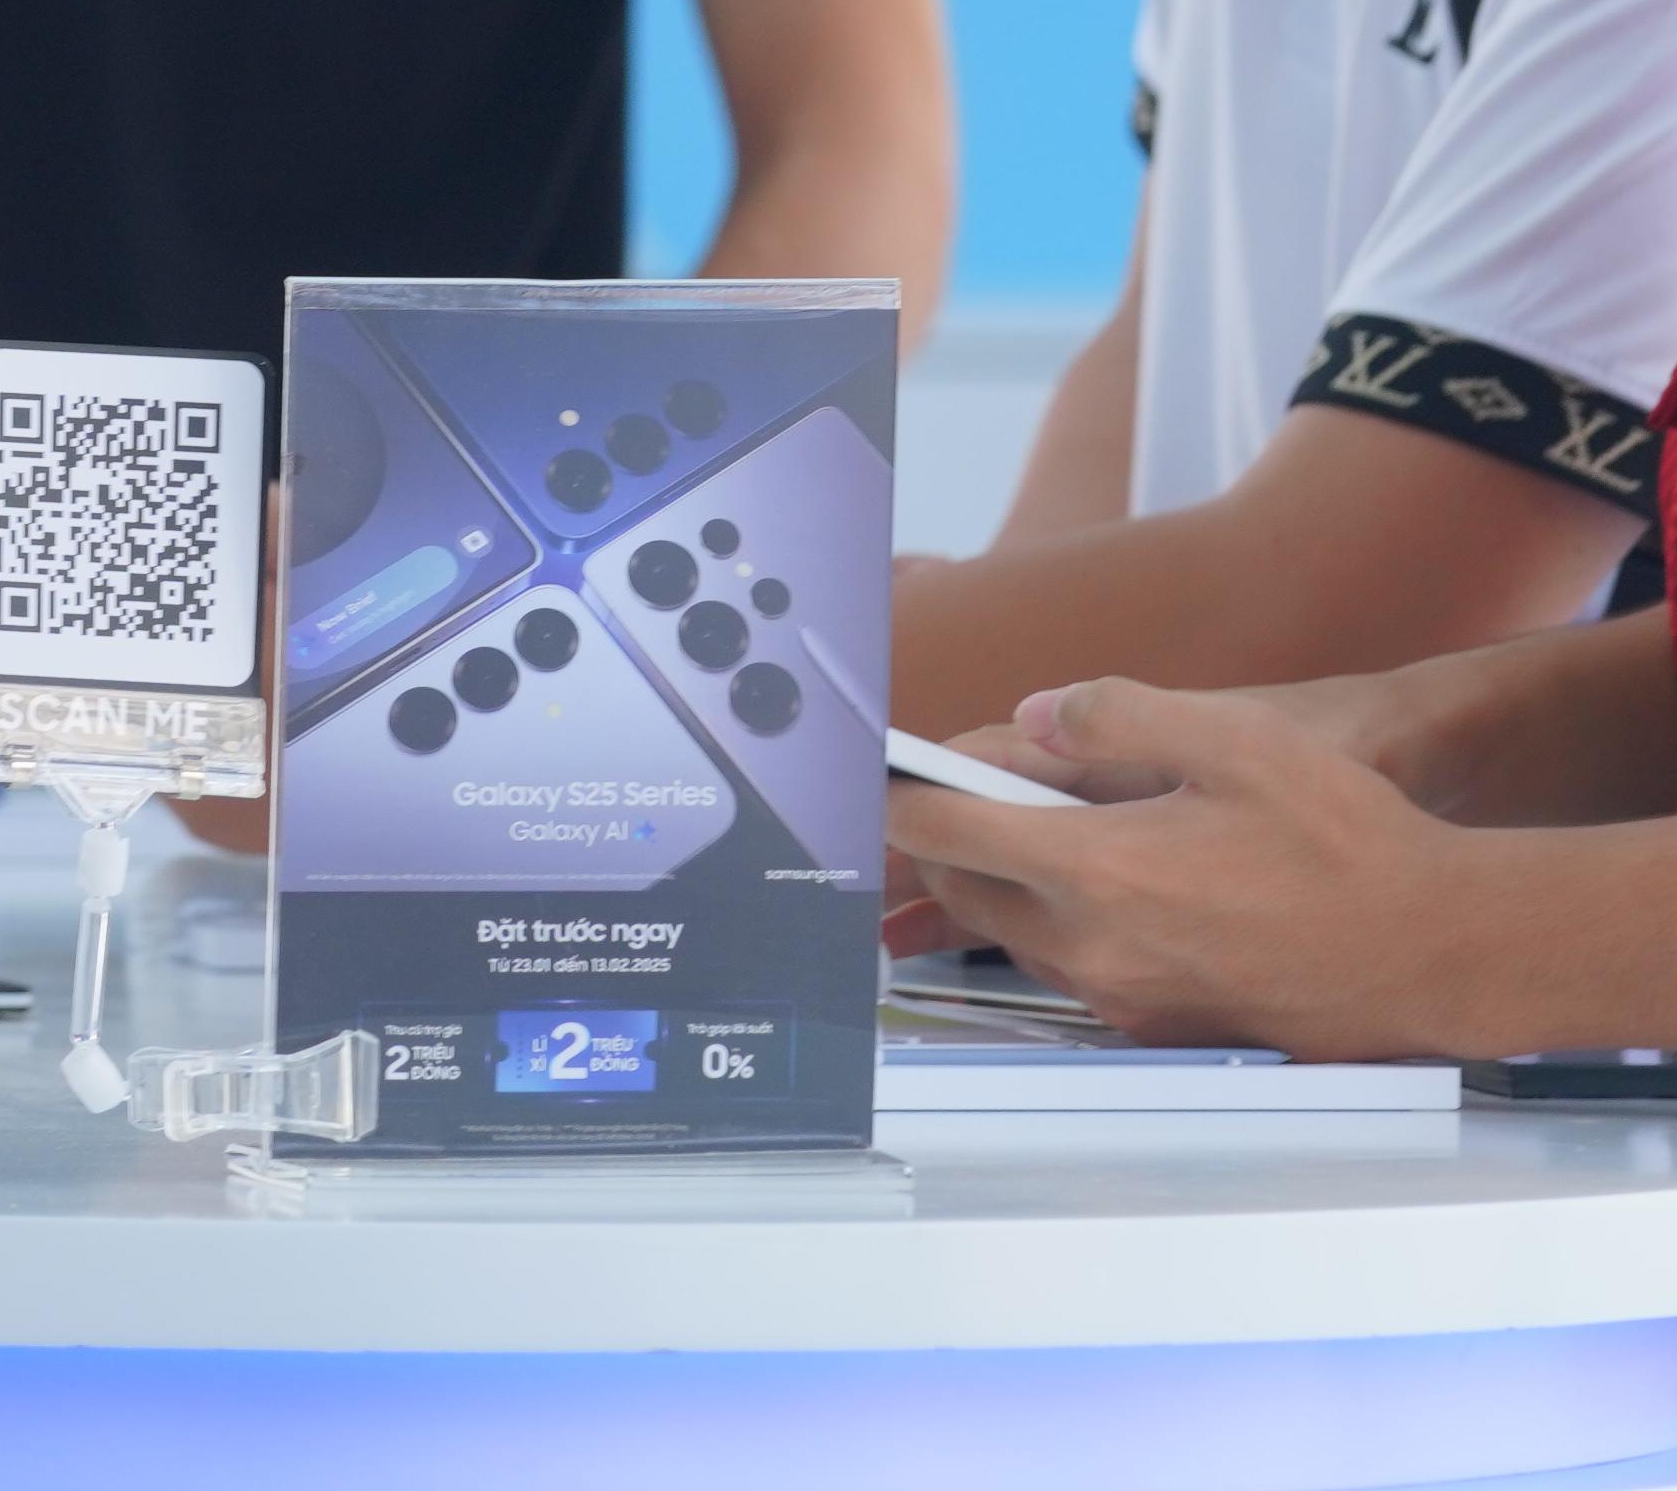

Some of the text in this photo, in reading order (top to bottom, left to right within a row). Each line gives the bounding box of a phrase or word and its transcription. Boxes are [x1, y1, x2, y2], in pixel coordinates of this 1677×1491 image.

[145, 699, 209, 742] ME
[452, 779, 718, 813] Galaxy S25 Series
[508, 820, 629, 848] Galaxy AI
[476, 917, 685, 950] Đặt trước ngay
[384, 1044, 411, 1080] 2
[549, 1021, 590, 1081] 2
[702, 1044, 755, 1080] 0%
